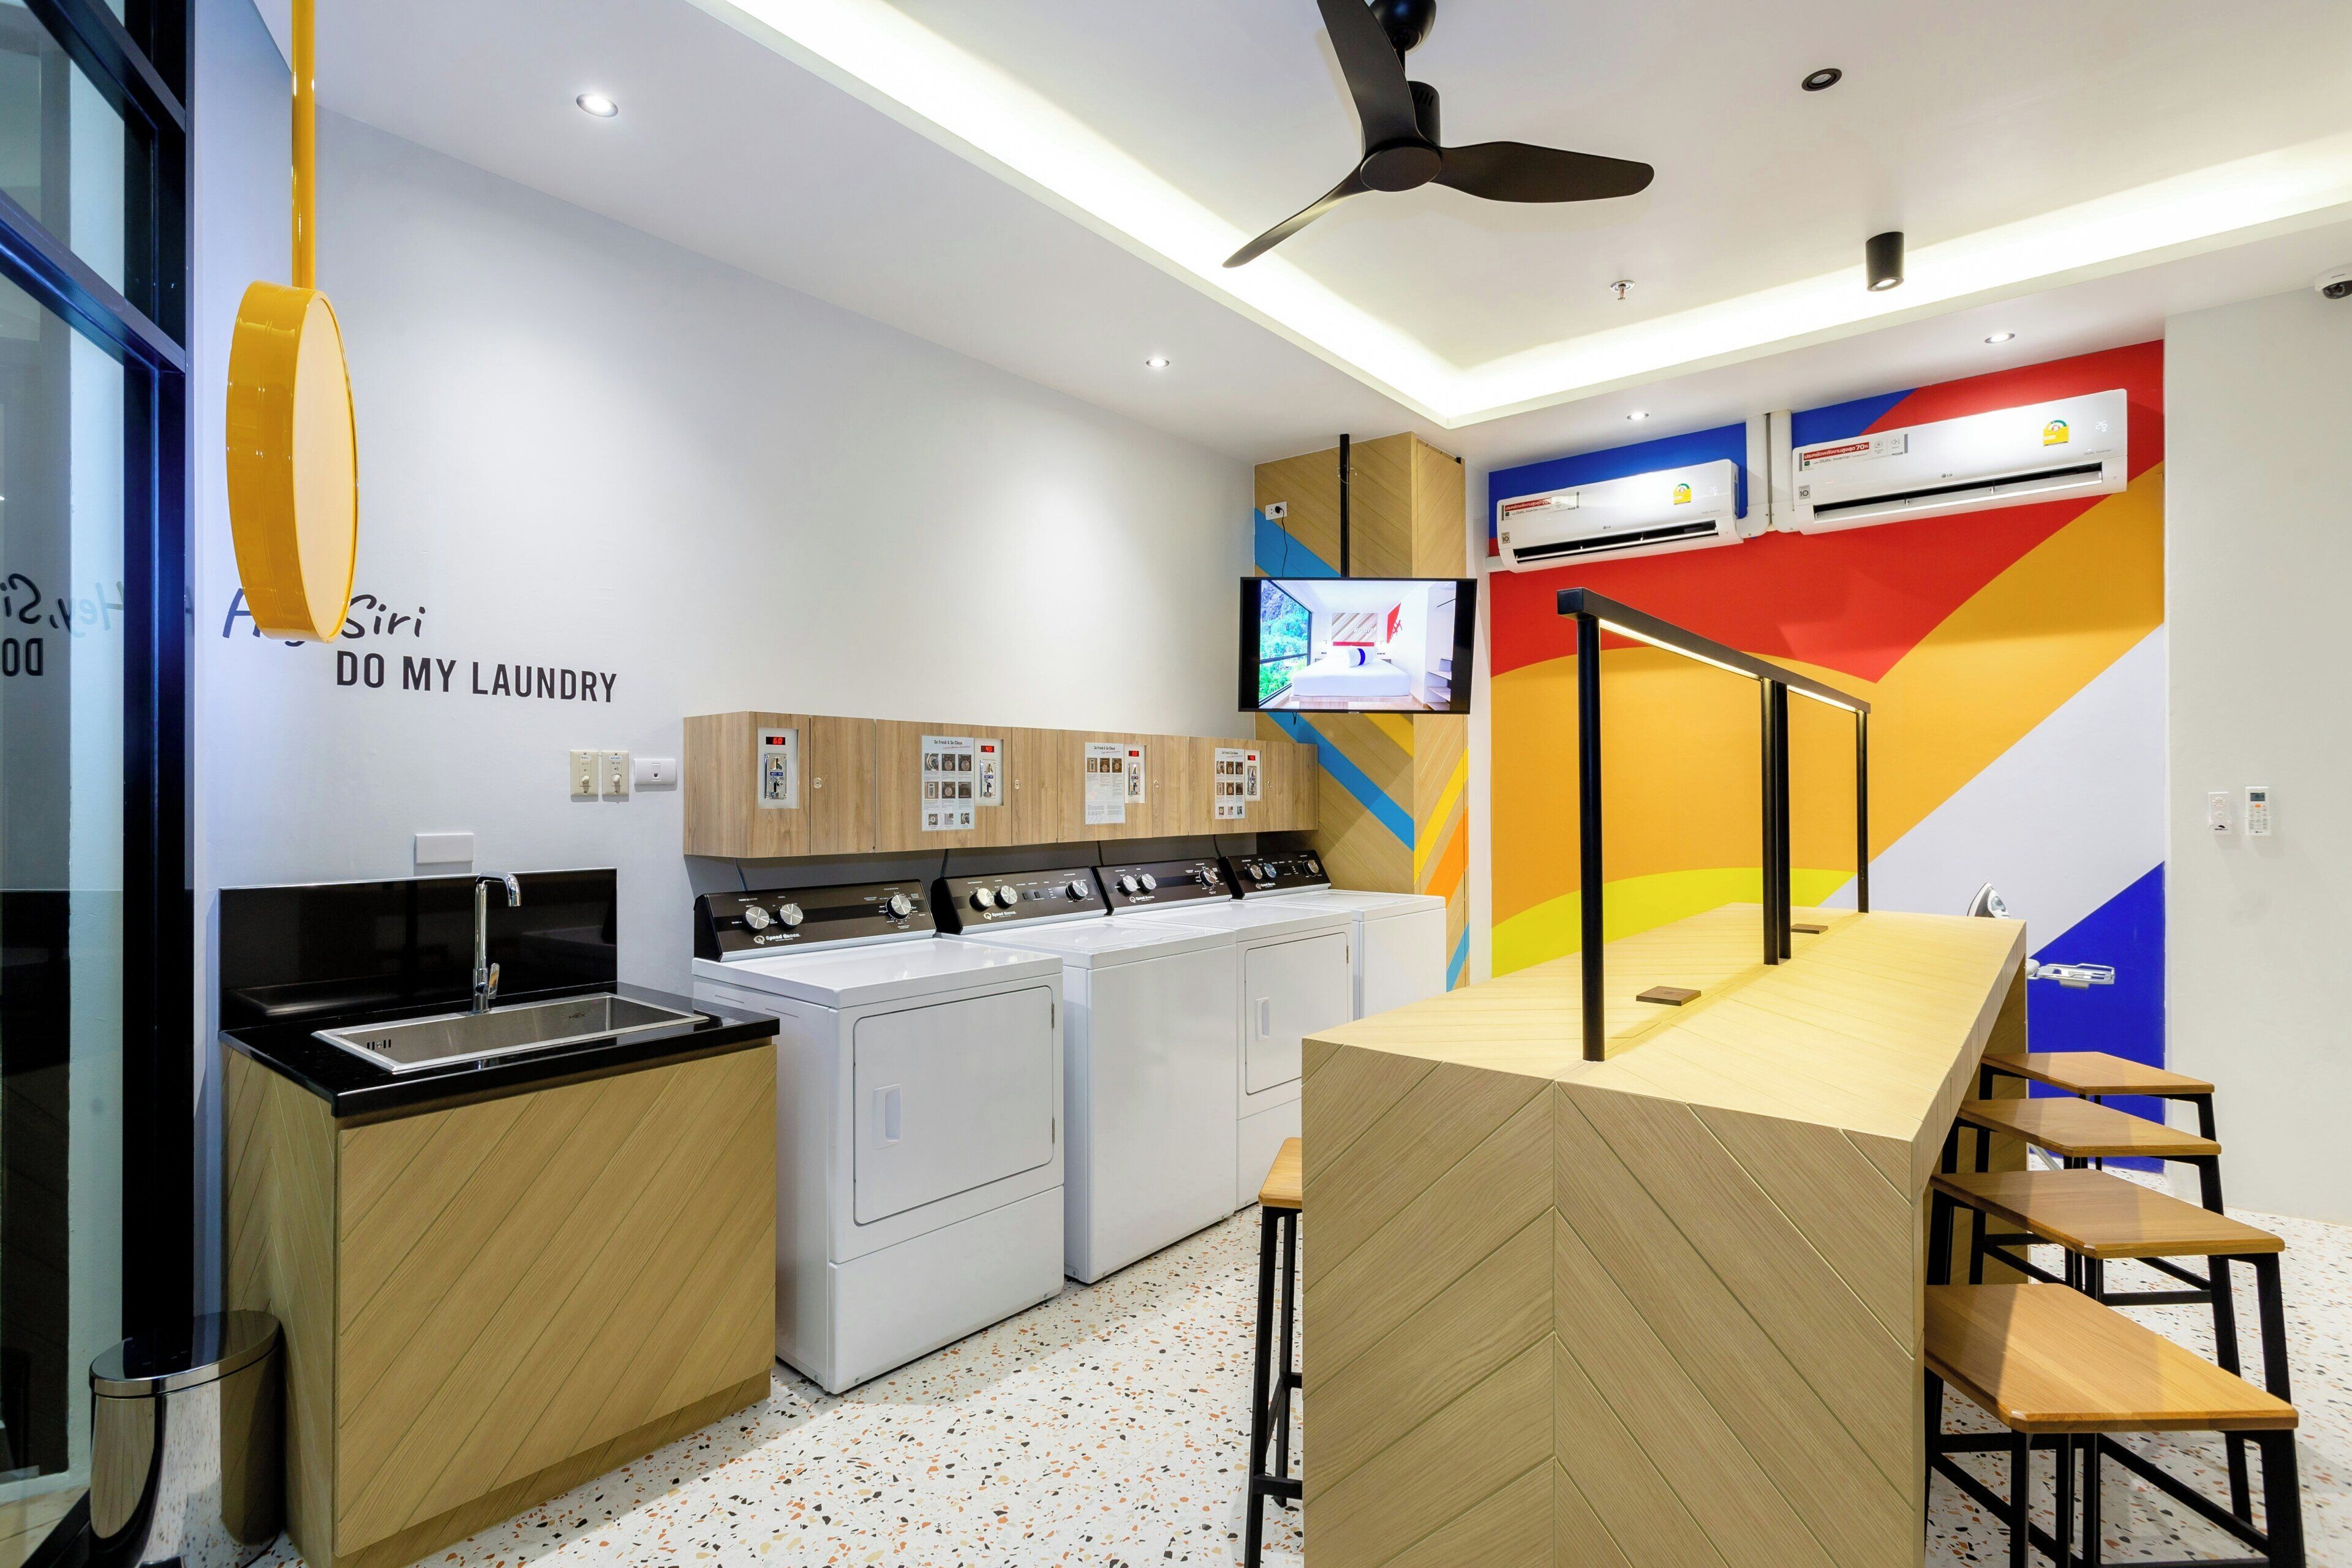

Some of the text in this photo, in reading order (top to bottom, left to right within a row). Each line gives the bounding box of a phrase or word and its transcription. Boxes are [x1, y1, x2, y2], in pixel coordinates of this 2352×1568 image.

[2095, 420, 2108, 430] 26
[341, 594, 426, 639] Siri
[337, 650, 617, 703] DO MY LAUNDRY
